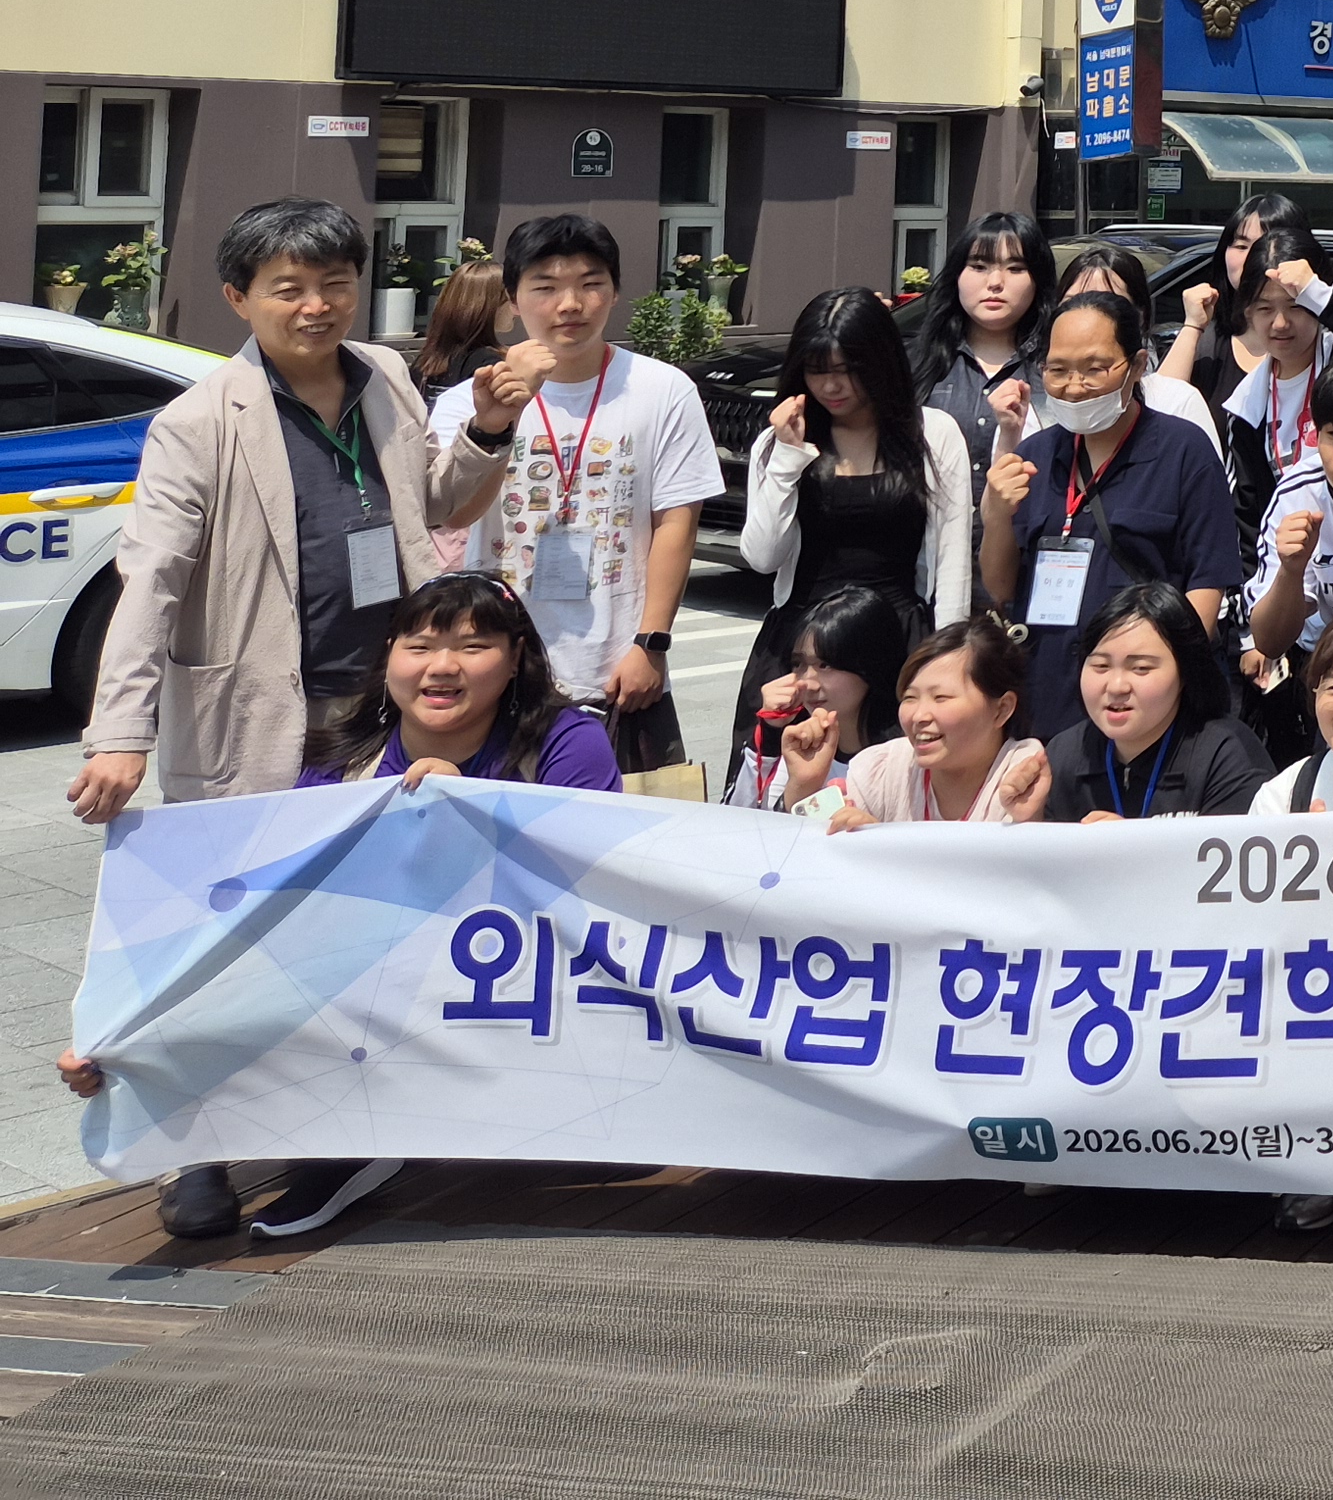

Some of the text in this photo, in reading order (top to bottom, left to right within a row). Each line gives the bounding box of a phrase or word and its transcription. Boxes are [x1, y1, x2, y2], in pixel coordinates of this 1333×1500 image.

[1086, 65, 1130, 92] 남대문
[1086, 93, 1130, 118] 파출소
[442, 908, 891, 1067] 외식산업
